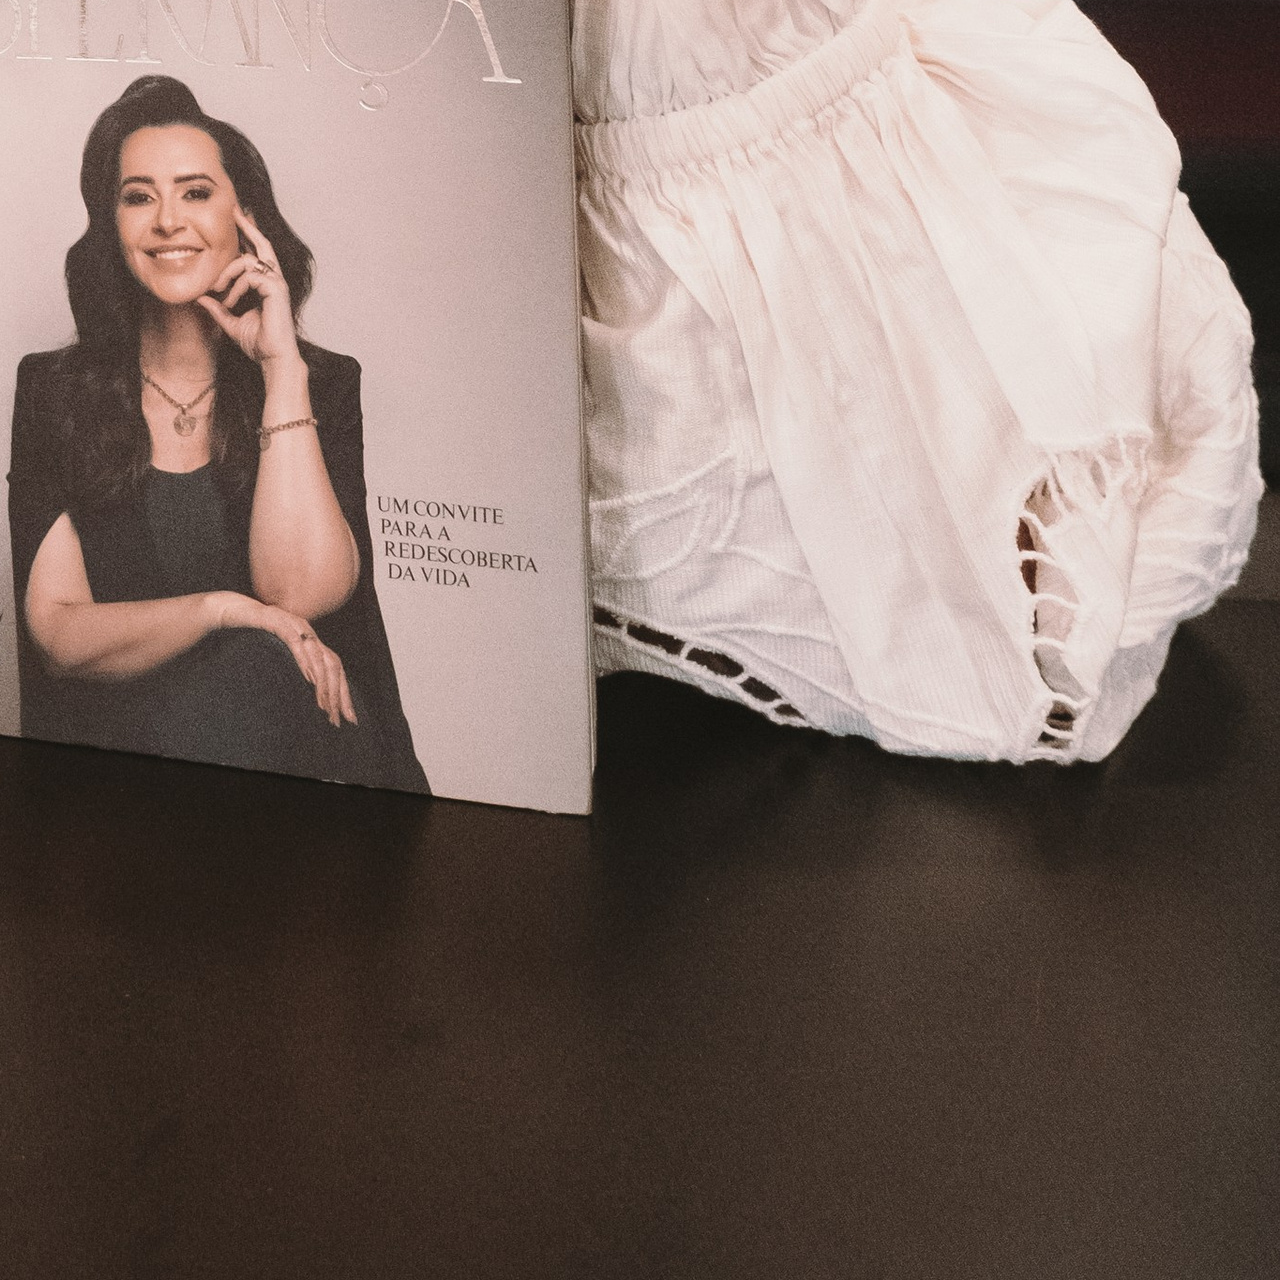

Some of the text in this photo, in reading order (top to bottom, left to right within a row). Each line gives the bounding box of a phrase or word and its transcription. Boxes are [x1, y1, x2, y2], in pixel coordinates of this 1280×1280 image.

[377, 495, 505, 525] UM CONVITE
[380, 518, 451, 541] PARA A
[384, 540, 539, 574] REDESCOBERTA
[388, 562, 471, 588] DA VIDA
